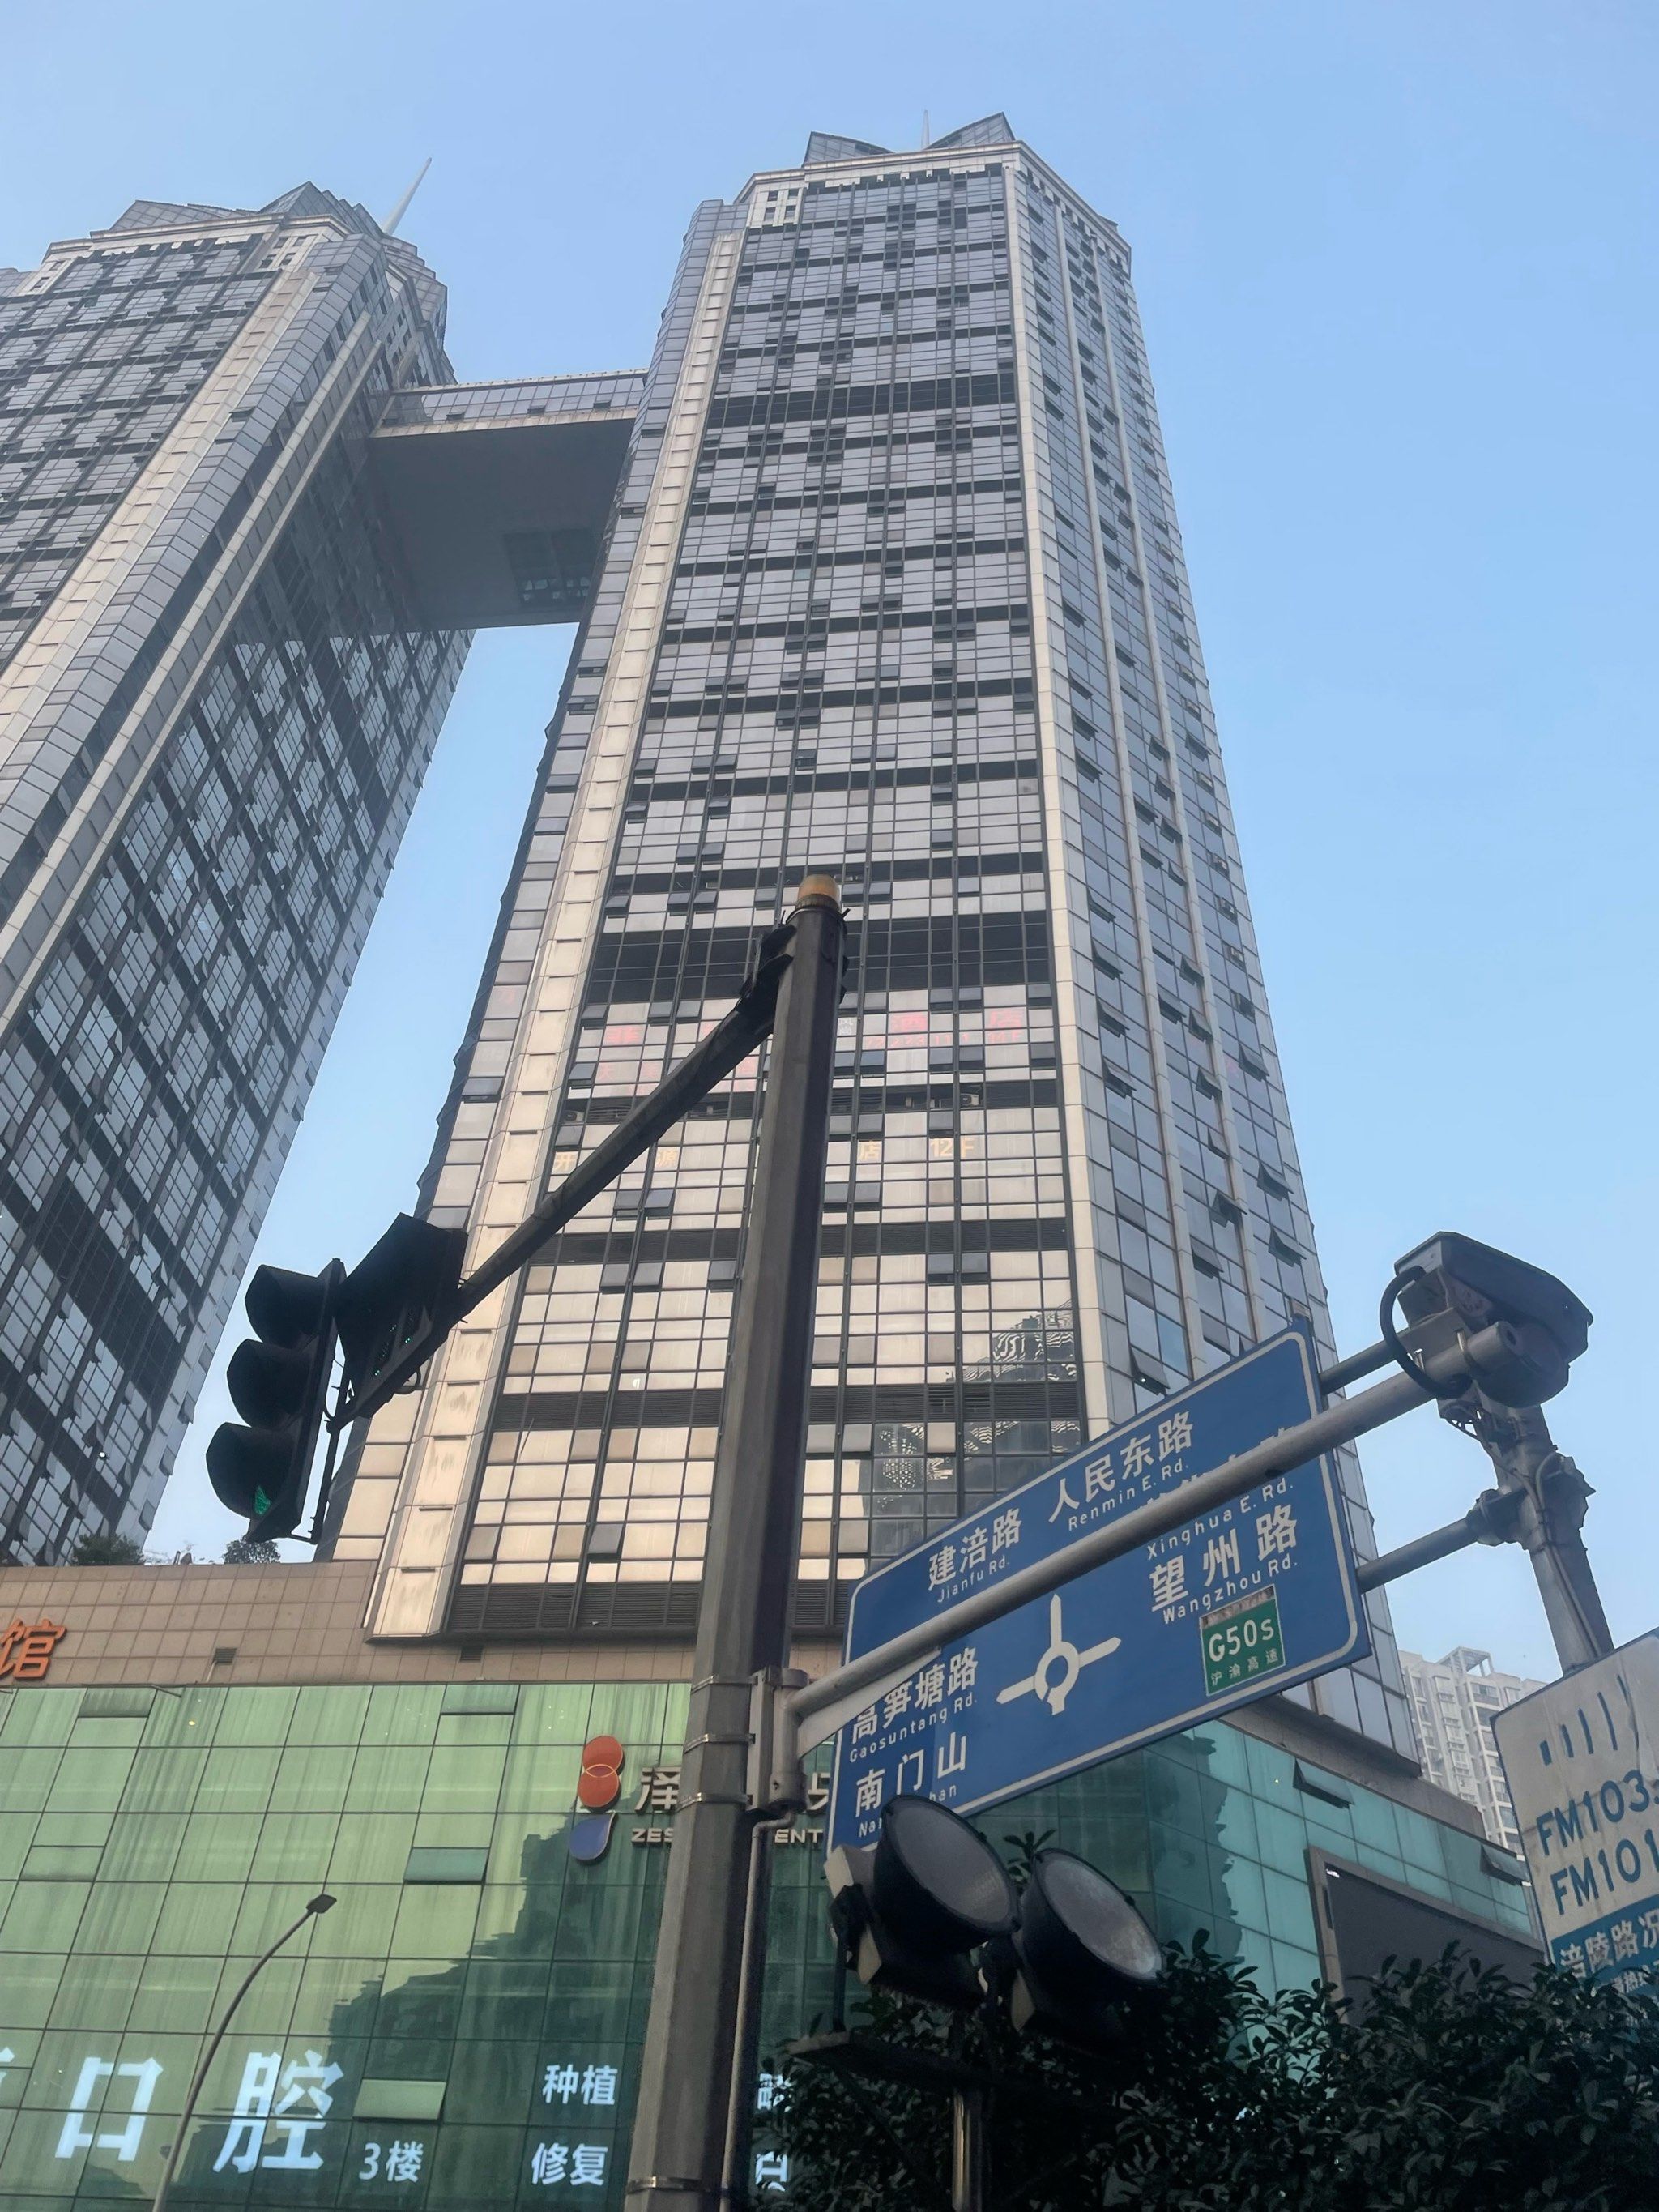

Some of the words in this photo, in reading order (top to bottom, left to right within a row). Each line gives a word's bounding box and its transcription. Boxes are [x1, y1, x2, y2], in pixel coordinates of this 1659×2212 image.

[1048, 1411, 1192, 1523] 人民东路
[1068, 1487, 1136, 1531] Renmin
[1142, 1475, 1157, 1492] E.
[1162, 1458, 1189, 1481] Rd.
[928, 1508, 1022, 1591] 建涪路
[1147, 1509, 1233, 1561] Xinghua
[1240, 1495, 1257, 1514] E.
[1262, 1477, 1294, 1502] Rd.
[937, 1570, 983, 1603] Jianfu
[989, 1555, 1010, 1575] Rd.
[1149, 1504, 1298, 1612] 望州路
[1162, 1570, 1261, 1625] Wangzhou
[1268, 1553, 1298, 1578] Rd.
[0, 1618, 67, 1680] 馆
[850, 1708, 948, 1763] Gaosuntang
[954, 1691, 978, 1714] Rd.
[852, 1646, 979, 1744] 高笋塘路
[855, 1732, 967, 1817] 南门山
[0, 2047, 344, 2173] 口腔
[542, 2064, 618, 2105] 种植
[359, 2141, 424, 2183] 3楼
[531, 2142, 608, 2186] 修复
